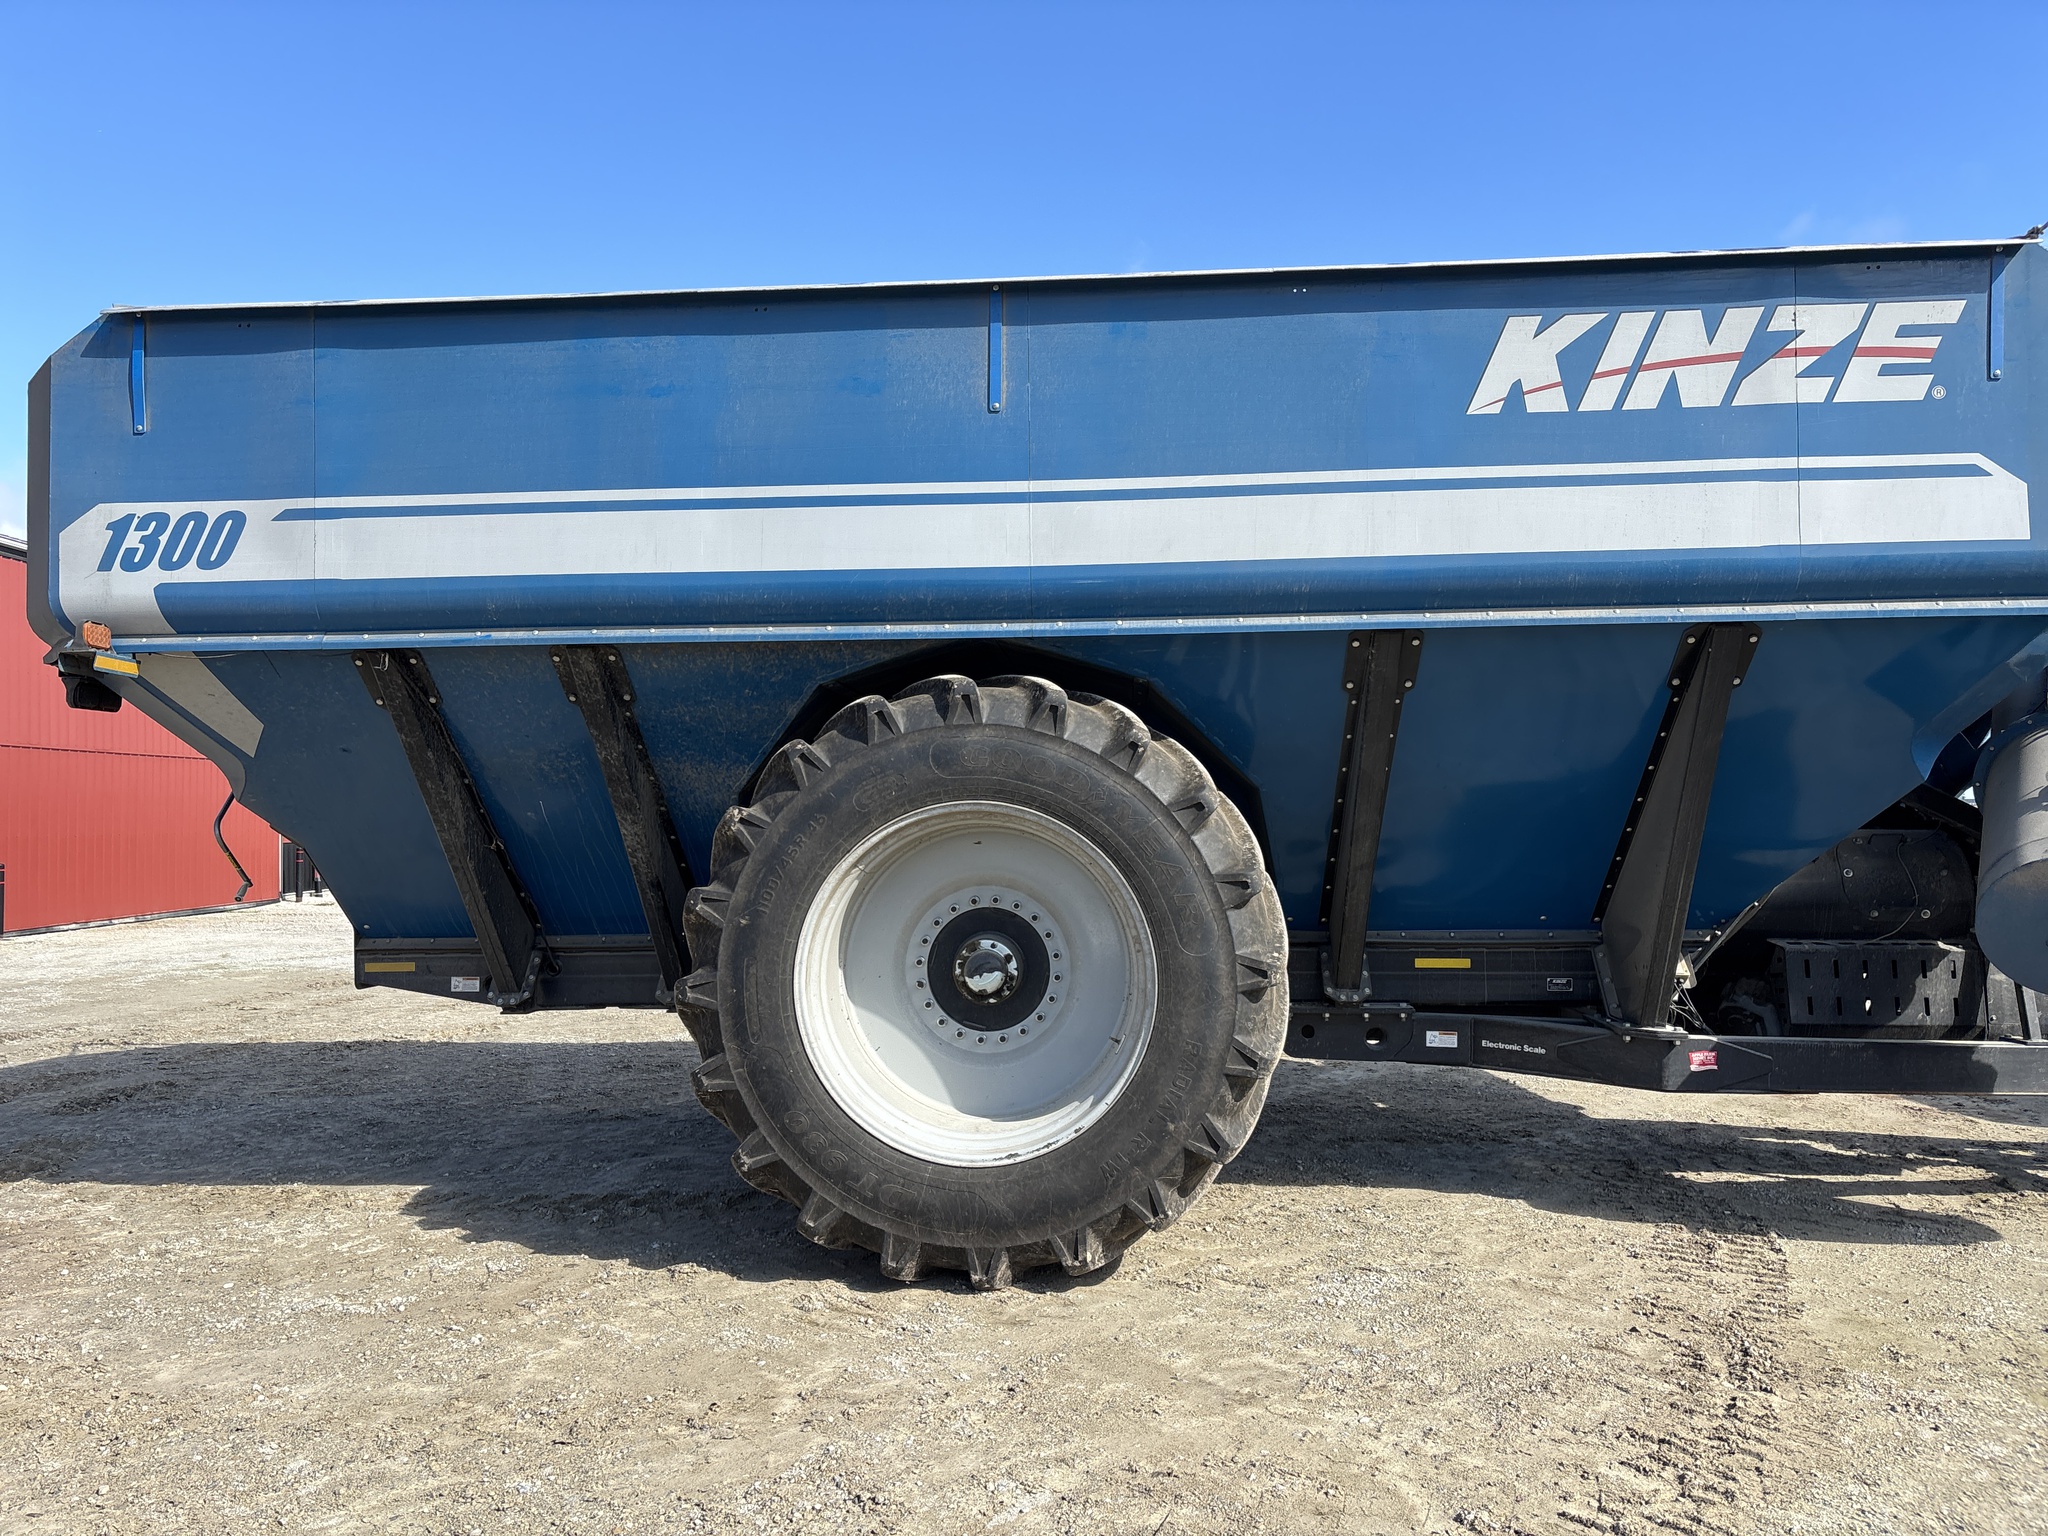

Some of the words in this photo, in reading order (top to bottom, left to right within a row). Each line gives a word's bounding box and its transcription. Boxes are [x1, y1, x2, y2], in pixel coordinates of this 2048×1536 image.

[1466, 299, 1968, 416] KINZE
[96, 510, 248, 573] 1300
[959, 745, 1206, 927] GOODYEAR
[1154, 1038, 1203, 1124] RADIAL
[1481, 1039, 1522, 1052] Electronic
[1523, 1044, 1547, 1055] Scale
